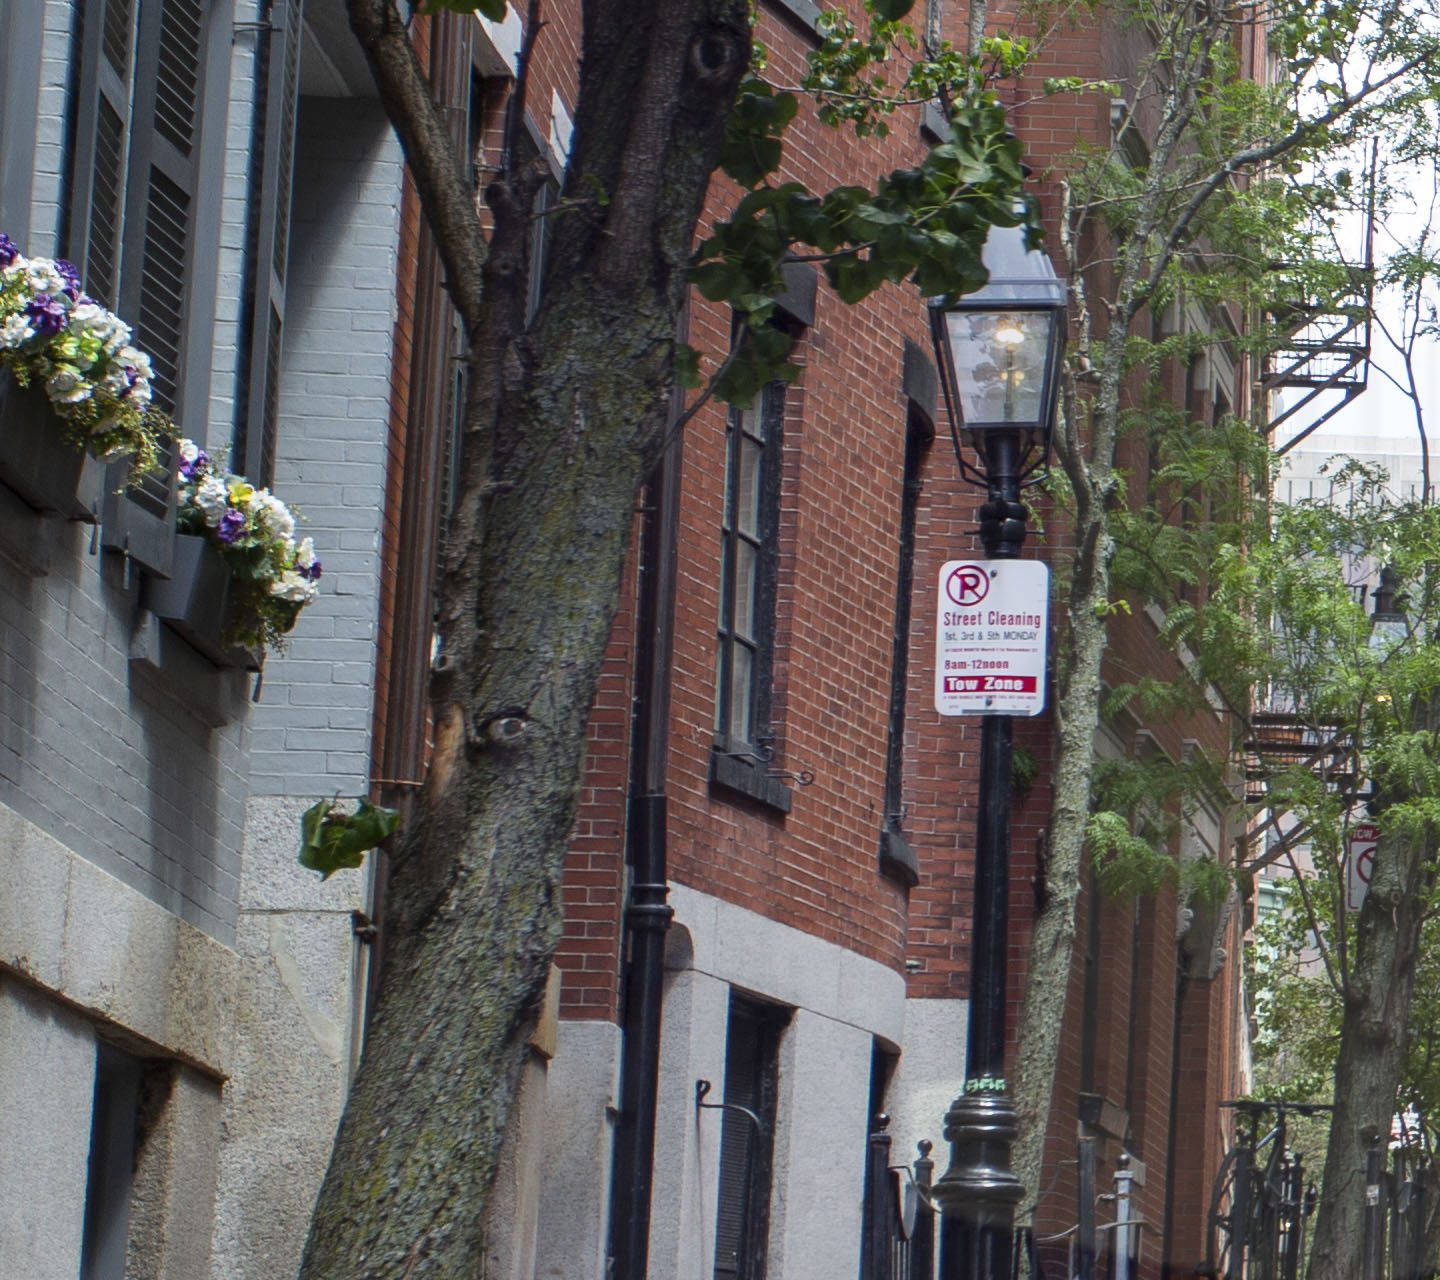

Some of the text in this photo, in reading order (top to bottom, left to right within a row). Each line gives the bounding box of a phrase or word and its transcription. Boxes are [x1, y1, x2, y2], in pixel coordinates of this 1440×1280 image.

[944, 611, 1041, 628] Street Cleaning
[987, 631, 1000, 640] 5th
[1003, 631, 1038, 640] MONDAY
[945, 660, 1008, 669] 8am-12noon
[947, 677, 1023, 690] Tow Zone
